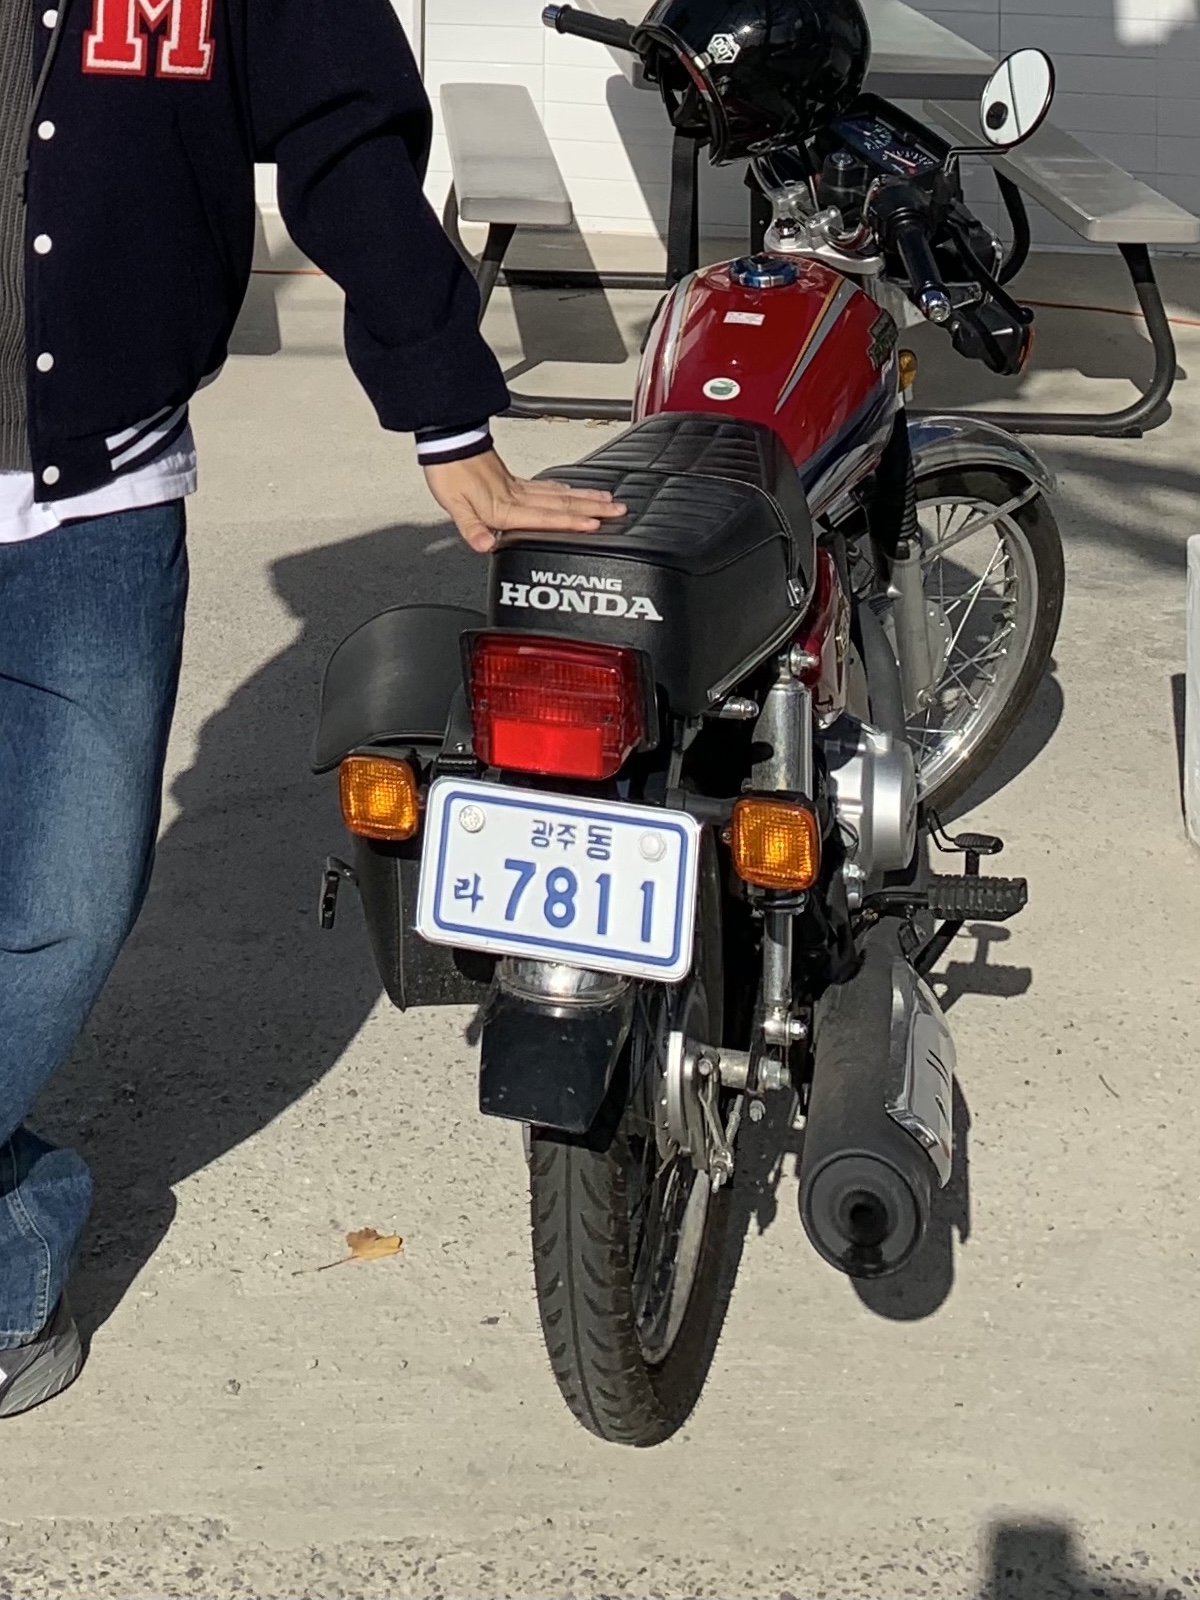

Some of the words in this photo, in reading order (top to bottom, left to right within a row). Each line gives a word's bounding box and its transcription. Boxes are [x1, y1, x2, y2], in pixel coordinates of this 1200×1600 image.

[499, 581, 664, 622] HONDA
[531, 570, 623, 592] WUYANG
[531, 819, 577, 850] 광주
[586, 825, 612, 861] 동
[454, 873, 484, 913] 라
[504, 858, 655, 944] 7811
